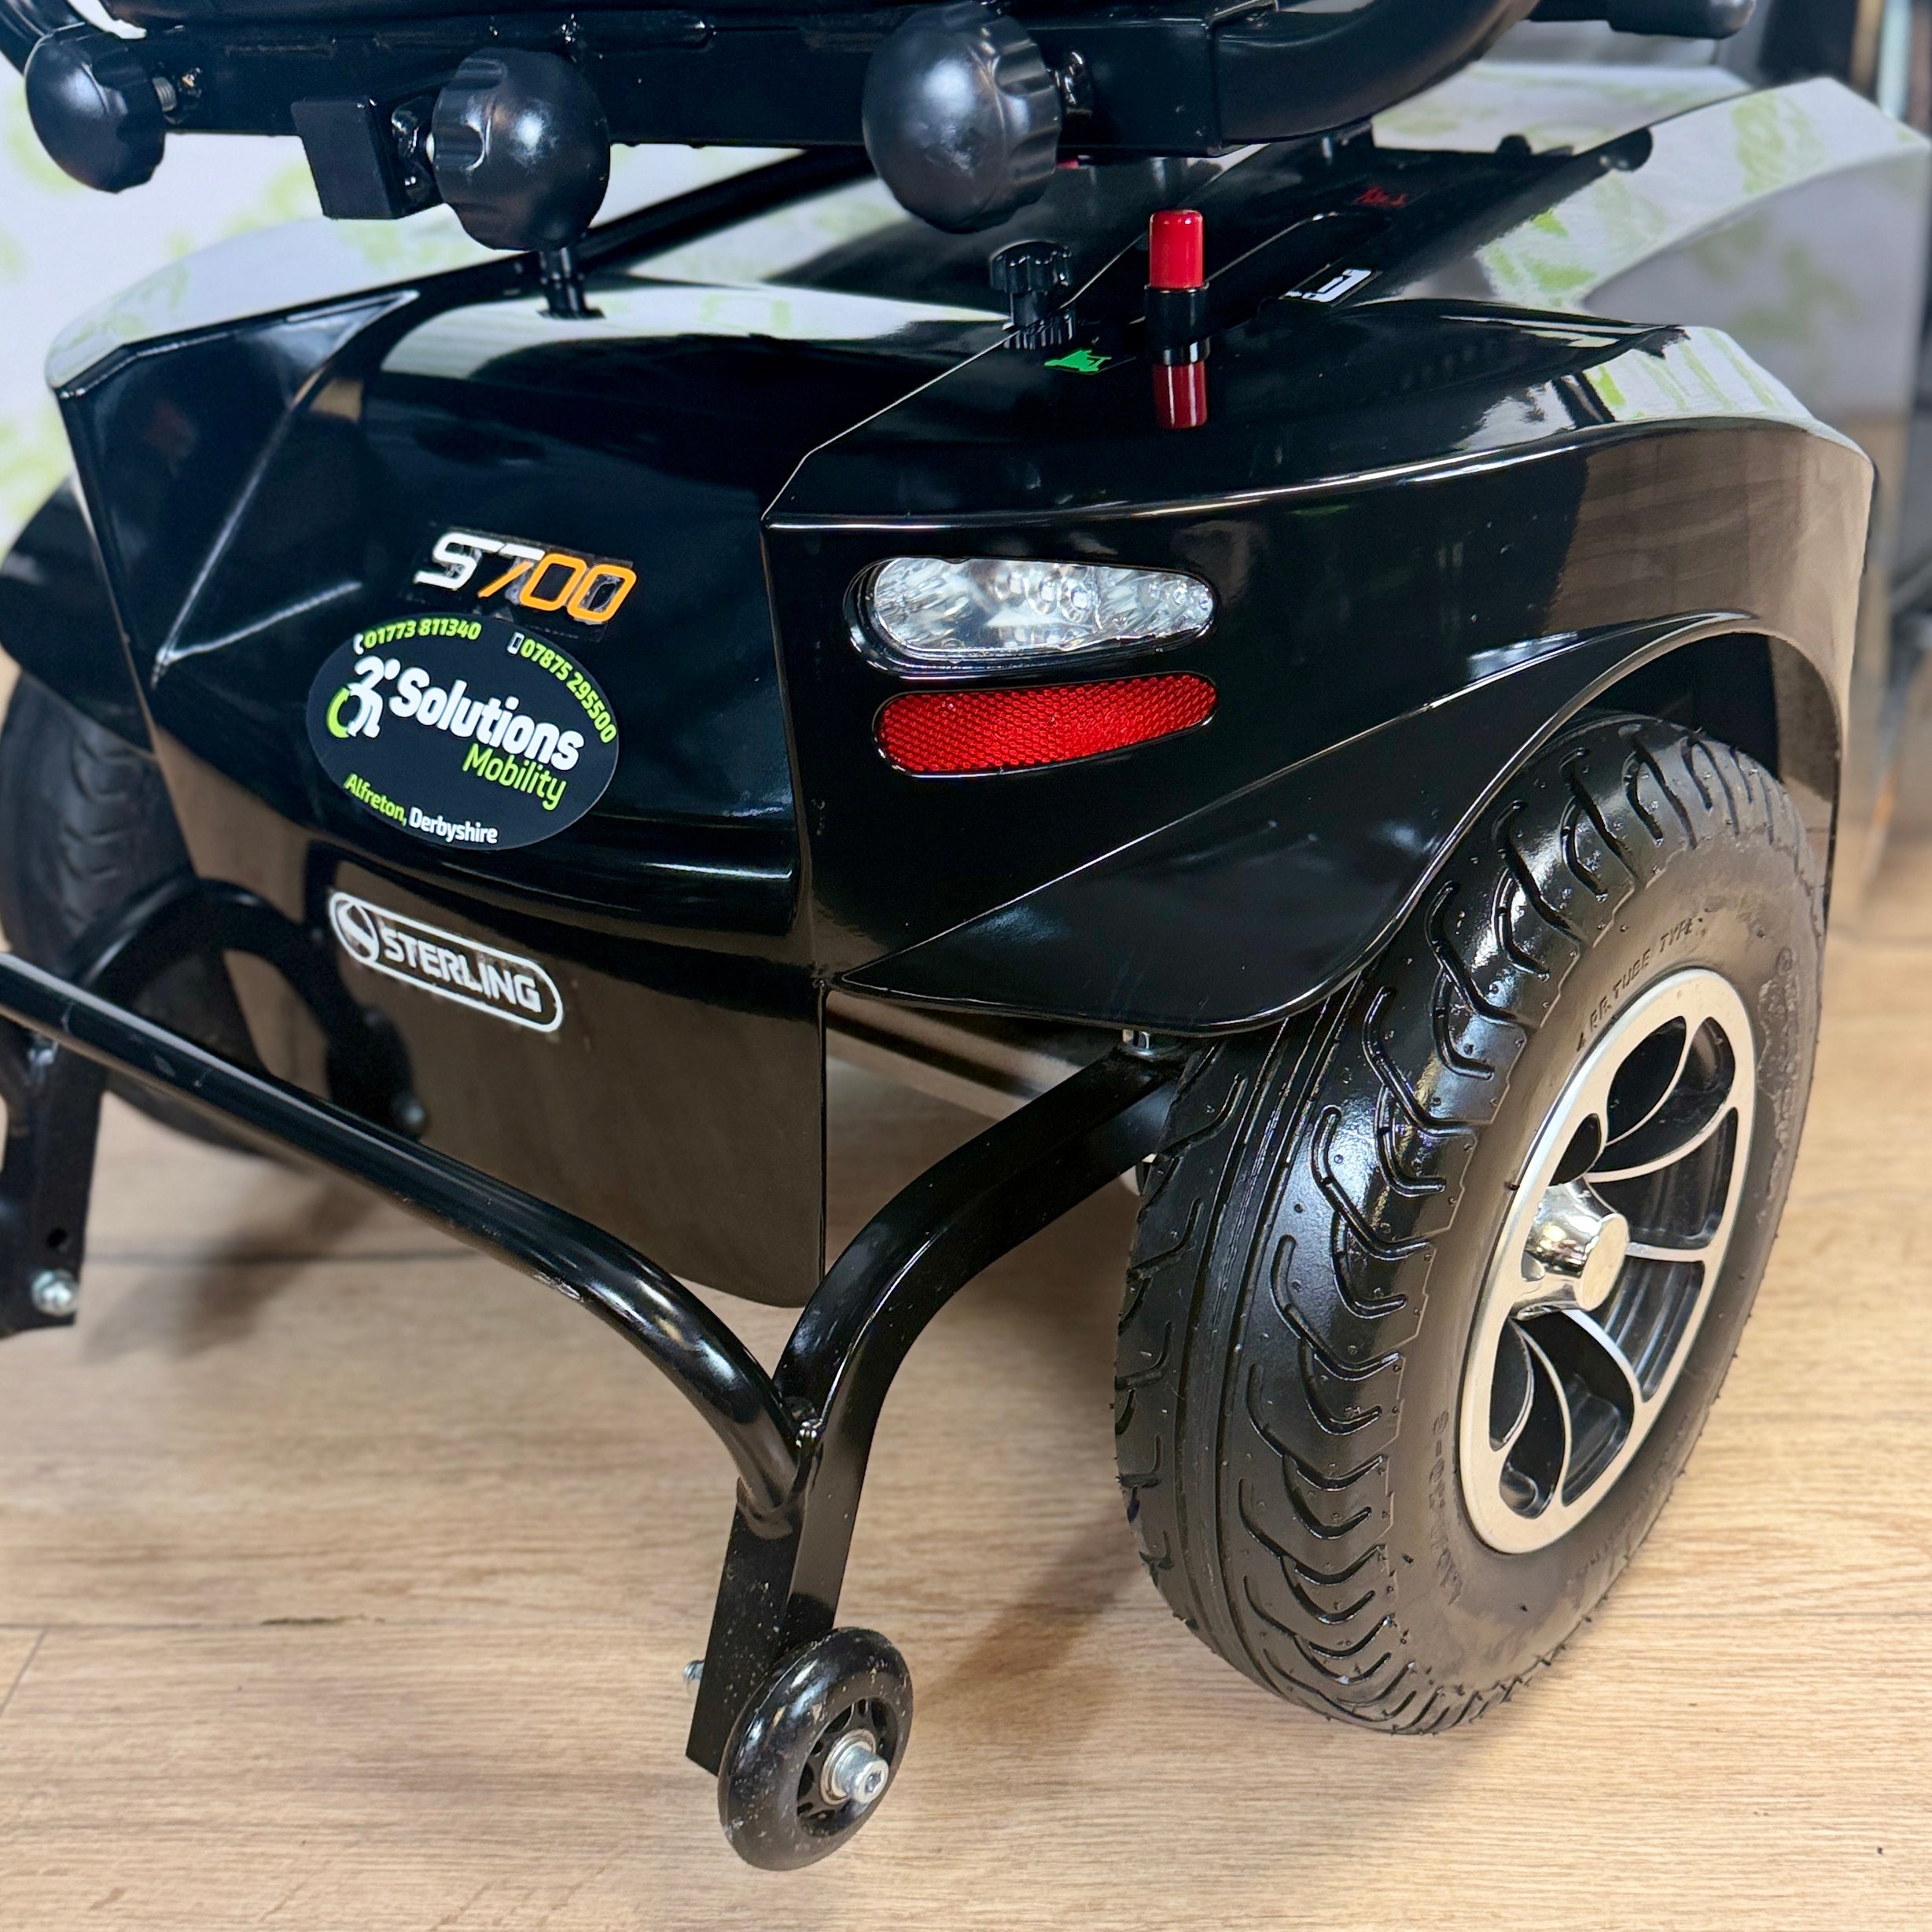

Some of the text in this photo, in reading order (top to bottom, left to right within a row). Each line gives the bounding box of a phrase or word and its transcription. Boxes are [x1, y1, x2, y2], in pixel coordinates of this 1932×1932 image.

[414, 531, 637, 624] S700
[363, 617, 482, 650] 01773 811340
[388, 667, 585, 771] Solutions
[521, 639, 618, 744] 07875 295500
[344, 774, 499, 845] Alfreton, Derbyshire
[462, 743, 567, 811] Mobility
[381, 926, 543, 1014] STERLING
[1613, 948, 1651, 999] TUBE
